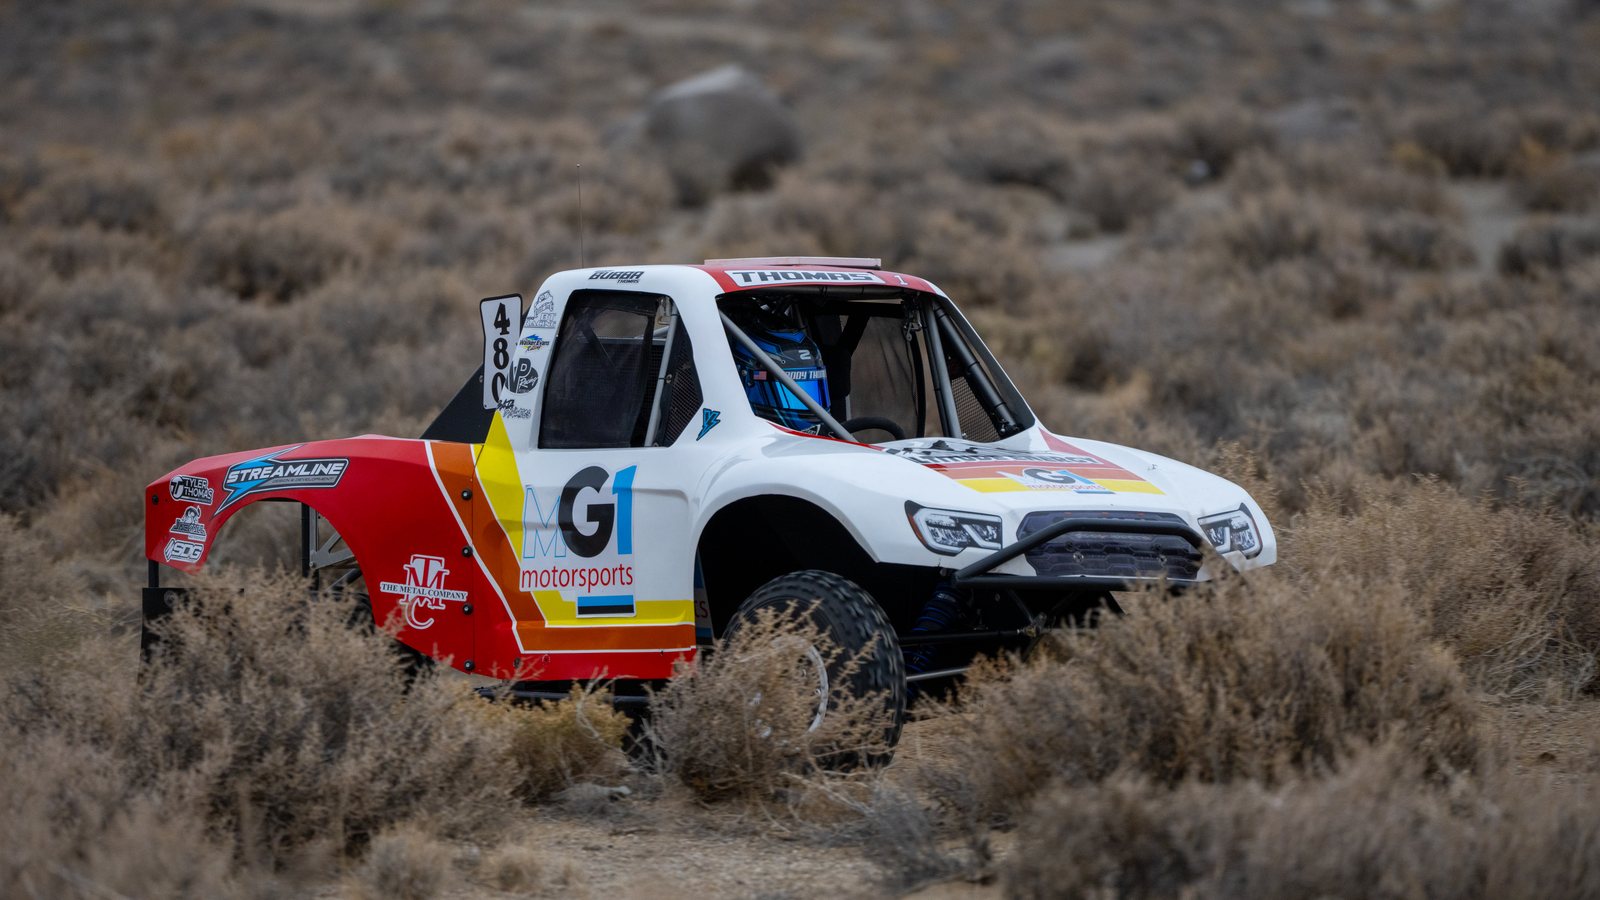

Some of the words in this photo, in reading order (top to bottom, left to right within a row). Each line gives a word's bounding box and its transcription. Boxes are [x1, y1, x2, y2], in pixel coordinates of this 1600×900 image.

[588, 270, 645, 280] BUBBA
[733, 271, 872, 282] THOMAS
[226, 463, 344, 484] STREAMLINE
[182, 477, 208, 489] TYLER
[184, 486, 213, 500] THOMAS
[521, 563, 634, 593] motorsports
[381, 583, 399, 592] THE
[399, 585, 427, 596] METAL
[428, 588, 467, 600] COMPANY
